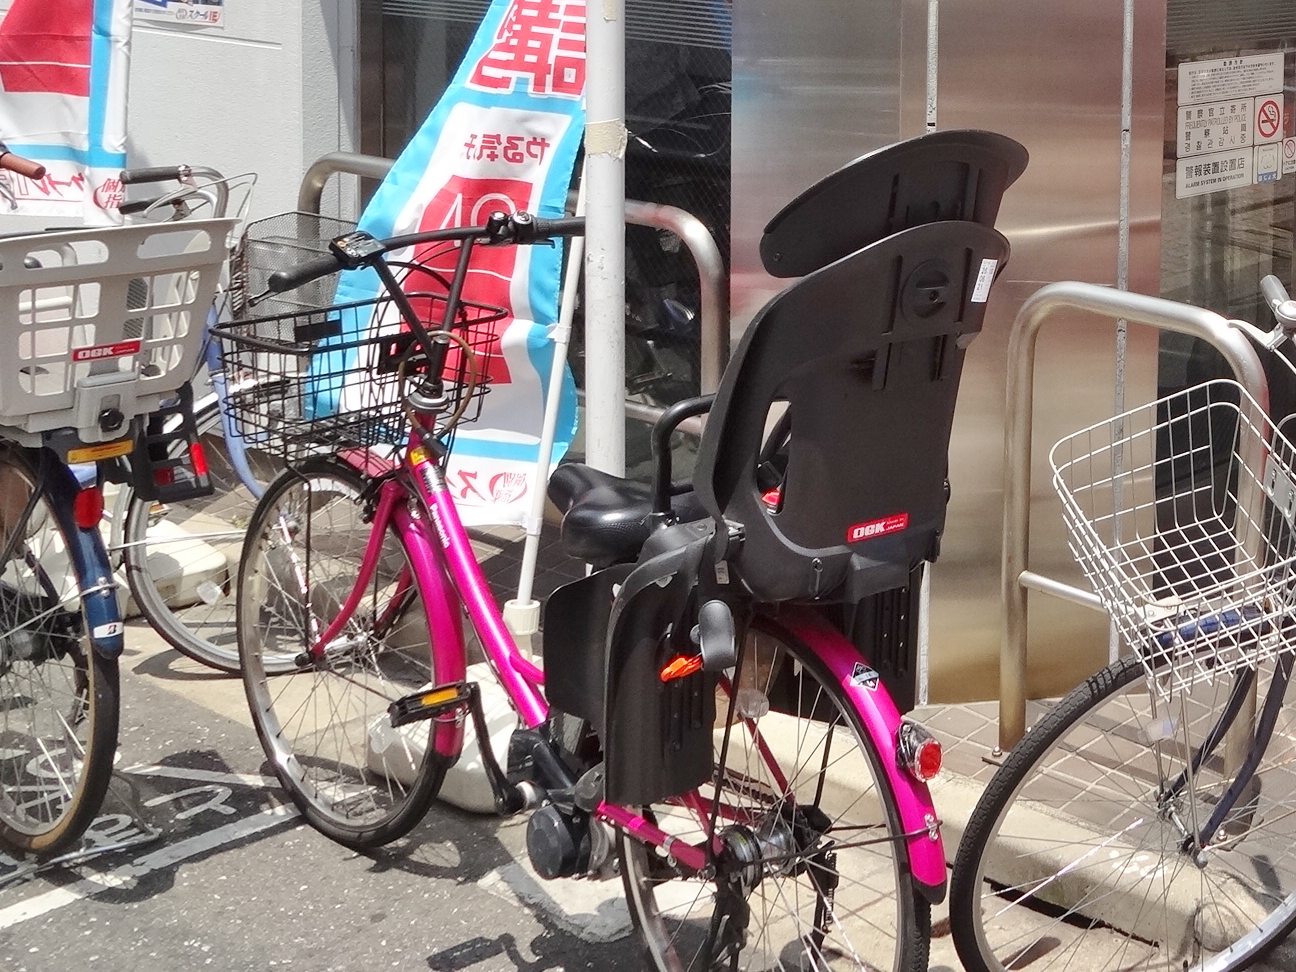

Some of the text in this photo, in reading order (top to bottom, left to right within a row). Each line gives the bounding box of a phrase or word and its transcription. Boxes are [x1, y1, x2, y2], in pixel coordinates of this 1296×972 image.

[1208, 116, 1228, 127] PATROLLED
[1234, 114, 1247, 123] POLICE
[1185, 157, 1245, 180] 警報装置設置店
[1185, 180, 1200, 189] ALARM
[1200, 177, 1217, 187] SYSTEM
[1222, 172, 1245, 182] OPERATION
[430, 502, 451, 549] Panasonic
[852, 521, 886, 539] OGK
